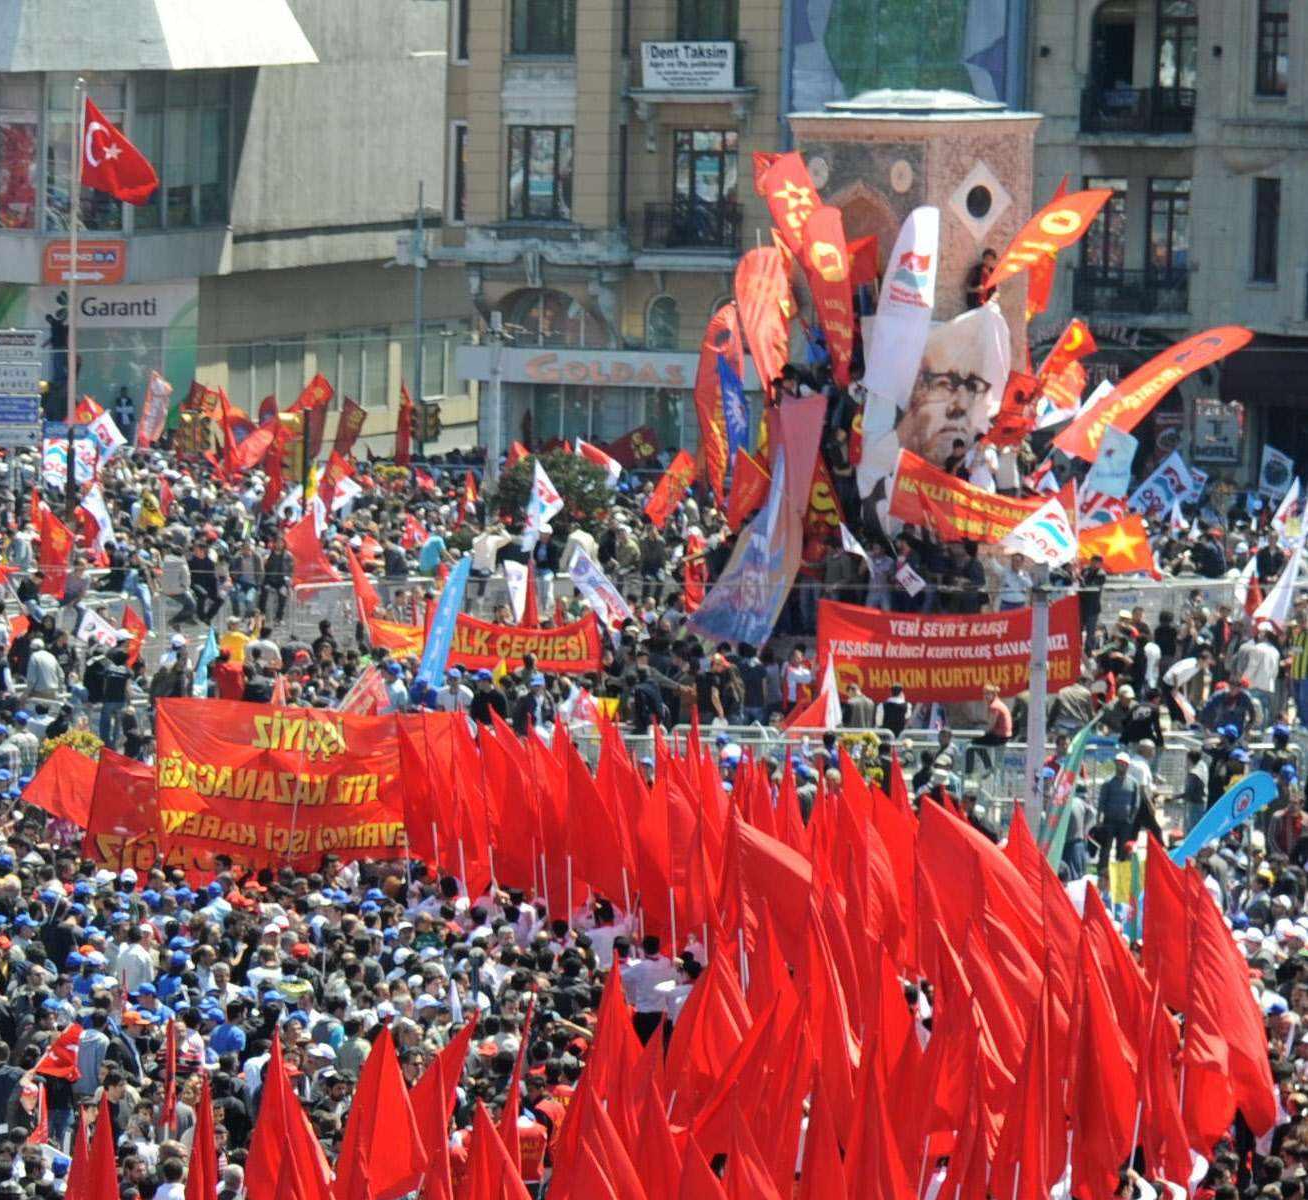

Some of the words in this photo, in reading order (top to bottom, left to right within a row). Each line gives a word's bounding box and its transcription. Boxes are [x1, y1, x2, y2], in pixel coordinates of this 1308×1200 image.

[651, 45, 680, 60] Dent
[683, 45, 729, 59] Taksim
[81, 297, 157, 317] Garanti
[889, 617, 920, 637] YENİ
[921, 619, 969, 638] SEVR'E
[971, 619, 1009, 640] KARŞI
[829, 639, 883, 661] YAŞASIN
[885, 640, 925, 659] İKİNCİ
[926, 643, 992, 661] KURTULUŞ
[869, 666, 927, 689] HALKIN
[931, 663, 1011, 690] KURTULUŞ
